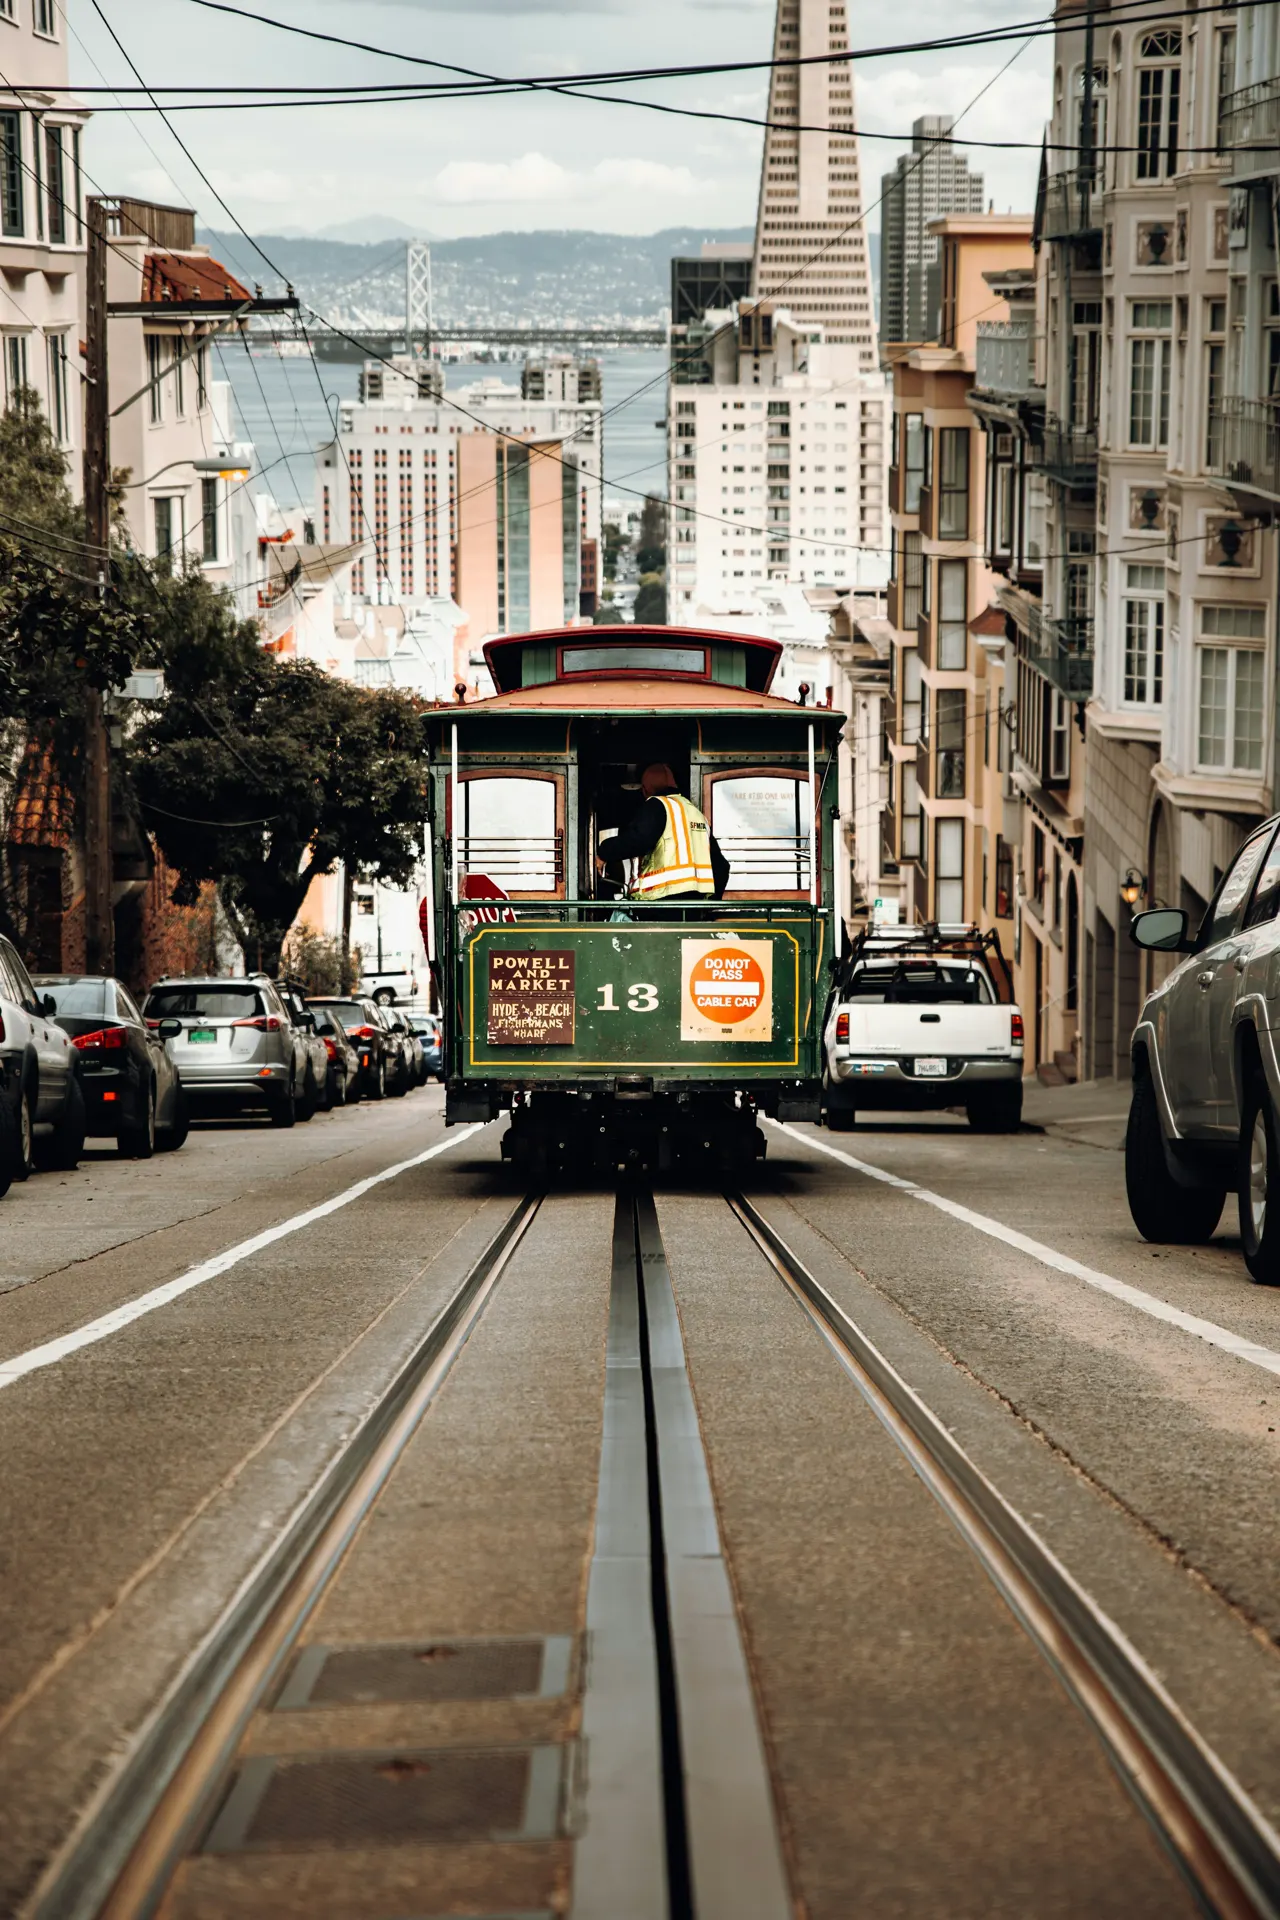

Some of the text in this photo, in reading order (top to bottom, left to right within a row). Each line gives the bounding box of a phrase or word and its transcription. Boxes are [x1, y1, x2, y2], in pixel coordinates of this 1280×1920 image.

[493, 957, 570, 970] POWELL
[705, 958, 751, 970] DO NOT
[512, 969, 551, 979] AND
[712, 969, 743, 980] PASS
[491, 979, 571, 991] MARKET
[597, 983, 660, 1012] 13
[697, 996, 757, 1008] CABLE CAR
[492, 1003, 519, 1017] HYDE
[535, 1003, 571, 1017] BEACH
[498, 1018, 564, 1029] FISHERMANS
[513, 1028, 547, 1039] WHARF
